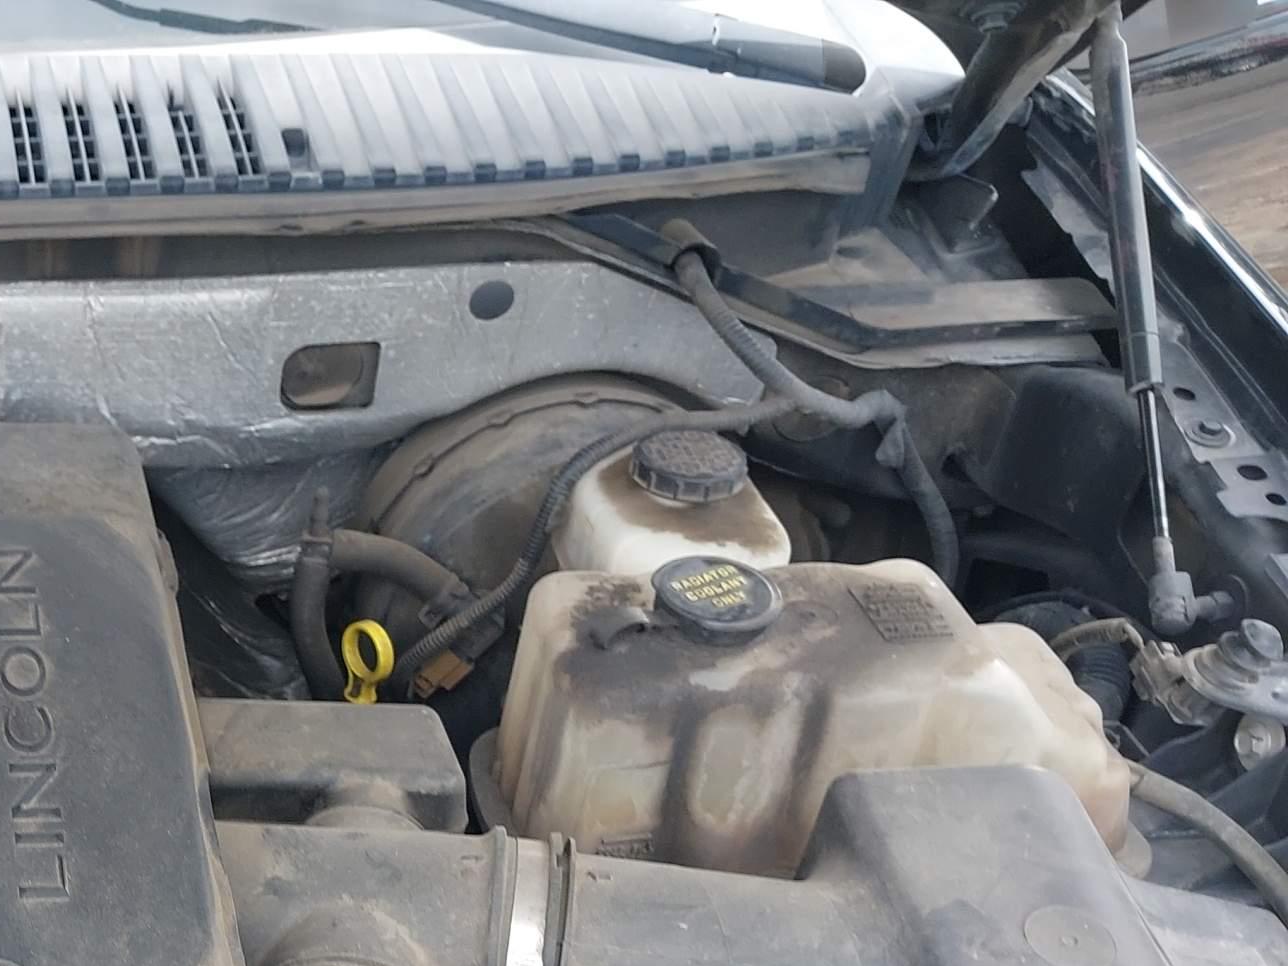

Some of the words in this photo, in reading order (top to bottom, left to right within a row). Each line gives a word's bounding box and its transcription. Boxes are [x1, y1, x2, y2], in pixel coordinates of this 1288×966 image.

[671, 564, 739, 592] RADIATOR
[685, 575, 748, 602] COOLANT
[712, 590, 747, 609] ONLY
